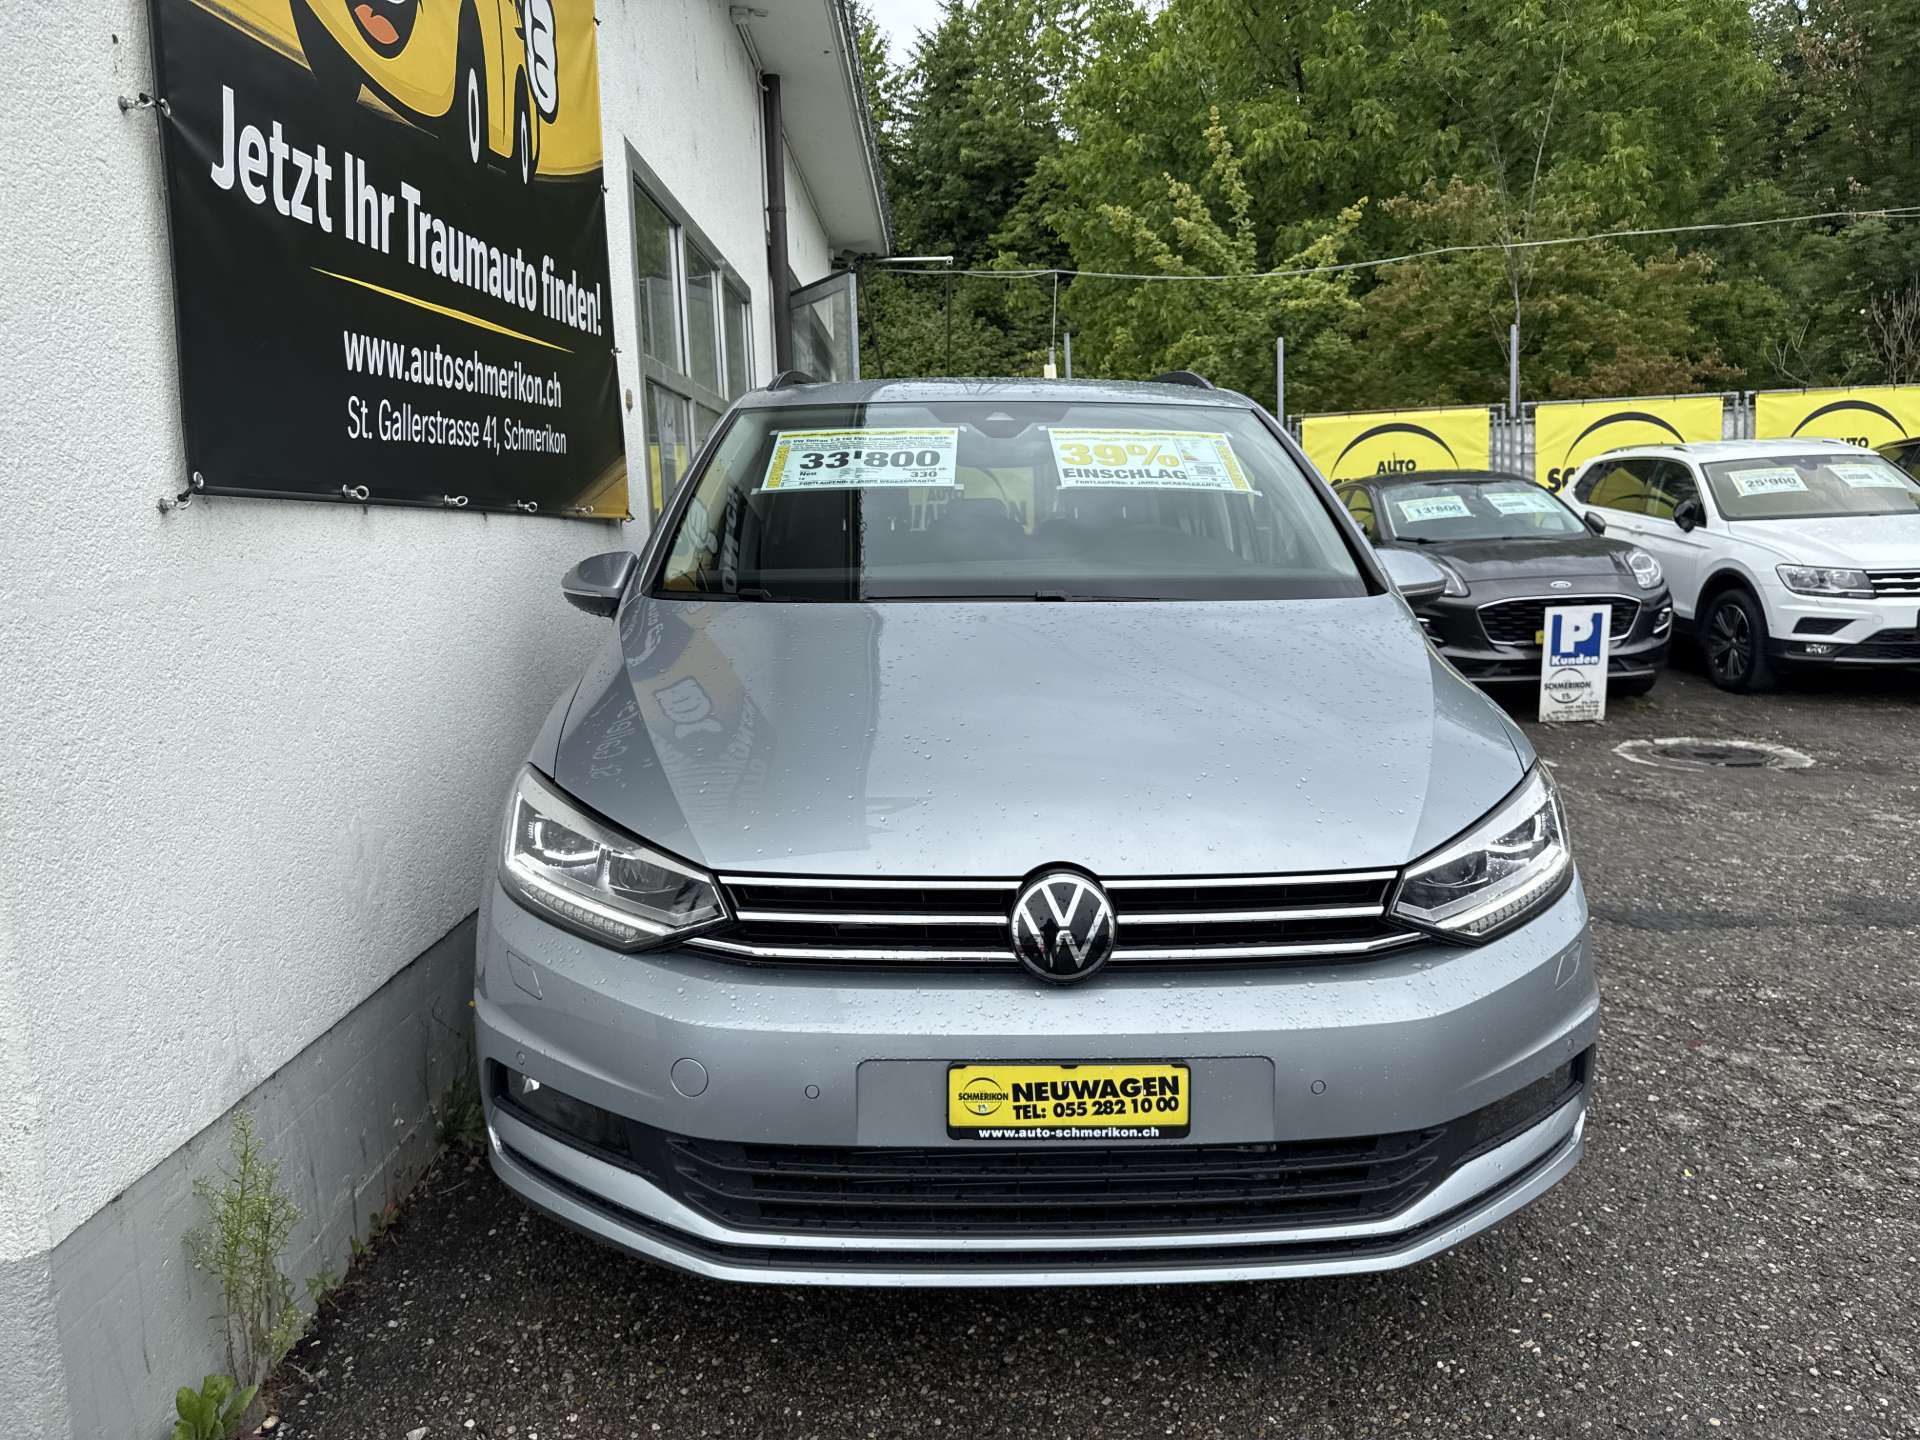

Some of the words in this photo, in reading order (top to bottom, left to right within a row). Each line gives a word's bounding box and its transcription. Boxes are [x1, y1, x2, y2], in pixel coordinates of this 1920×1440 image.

[211, 84, 333, 233] Jetzt
[344, 151, 395, 254] Ihr
[401, 181, 537, 312] Traumauto
[541, 255, 602, 336] finden!
[344, 330, 562, 408] www.autoschmerikon.ch
[347, 396, 374, 440] St.
[378, 399, 480, 447] Gallerstrasse
[482, 415, 500, 456] 41,
[503, 418, 567, 454] Schmerikon
[800, 450, 941, 470] 33'800
[1060, 443, 1180, 468] 39%
[910, 471, 938, 479] 330
[1063, 468, 1188, 480] EINSCHLAG
[1376, 460, 1416, 474] AUTO
[1559, 612, 1594, 653] P
[1550, 654, 1599, 667] Kunden
[1544, 681, 1592, 691] SCHMERIKON
[958, 1092, 1009, 1101] SCHMERIKON
[1012, 1076, 1180, 1102] NEUWAGEN
[1013, 1104, 1047, 1120] TEL:
[1053, 1102, 1088, 1118] 055
[1092, 1099, 1127, 1116] 282
[1131, 1098, 1153, 1114] 10
[1156, 1096, 1179, 1112] 00
[978, 1127, 1160, 1138] www.auto-schmerikon.ch
